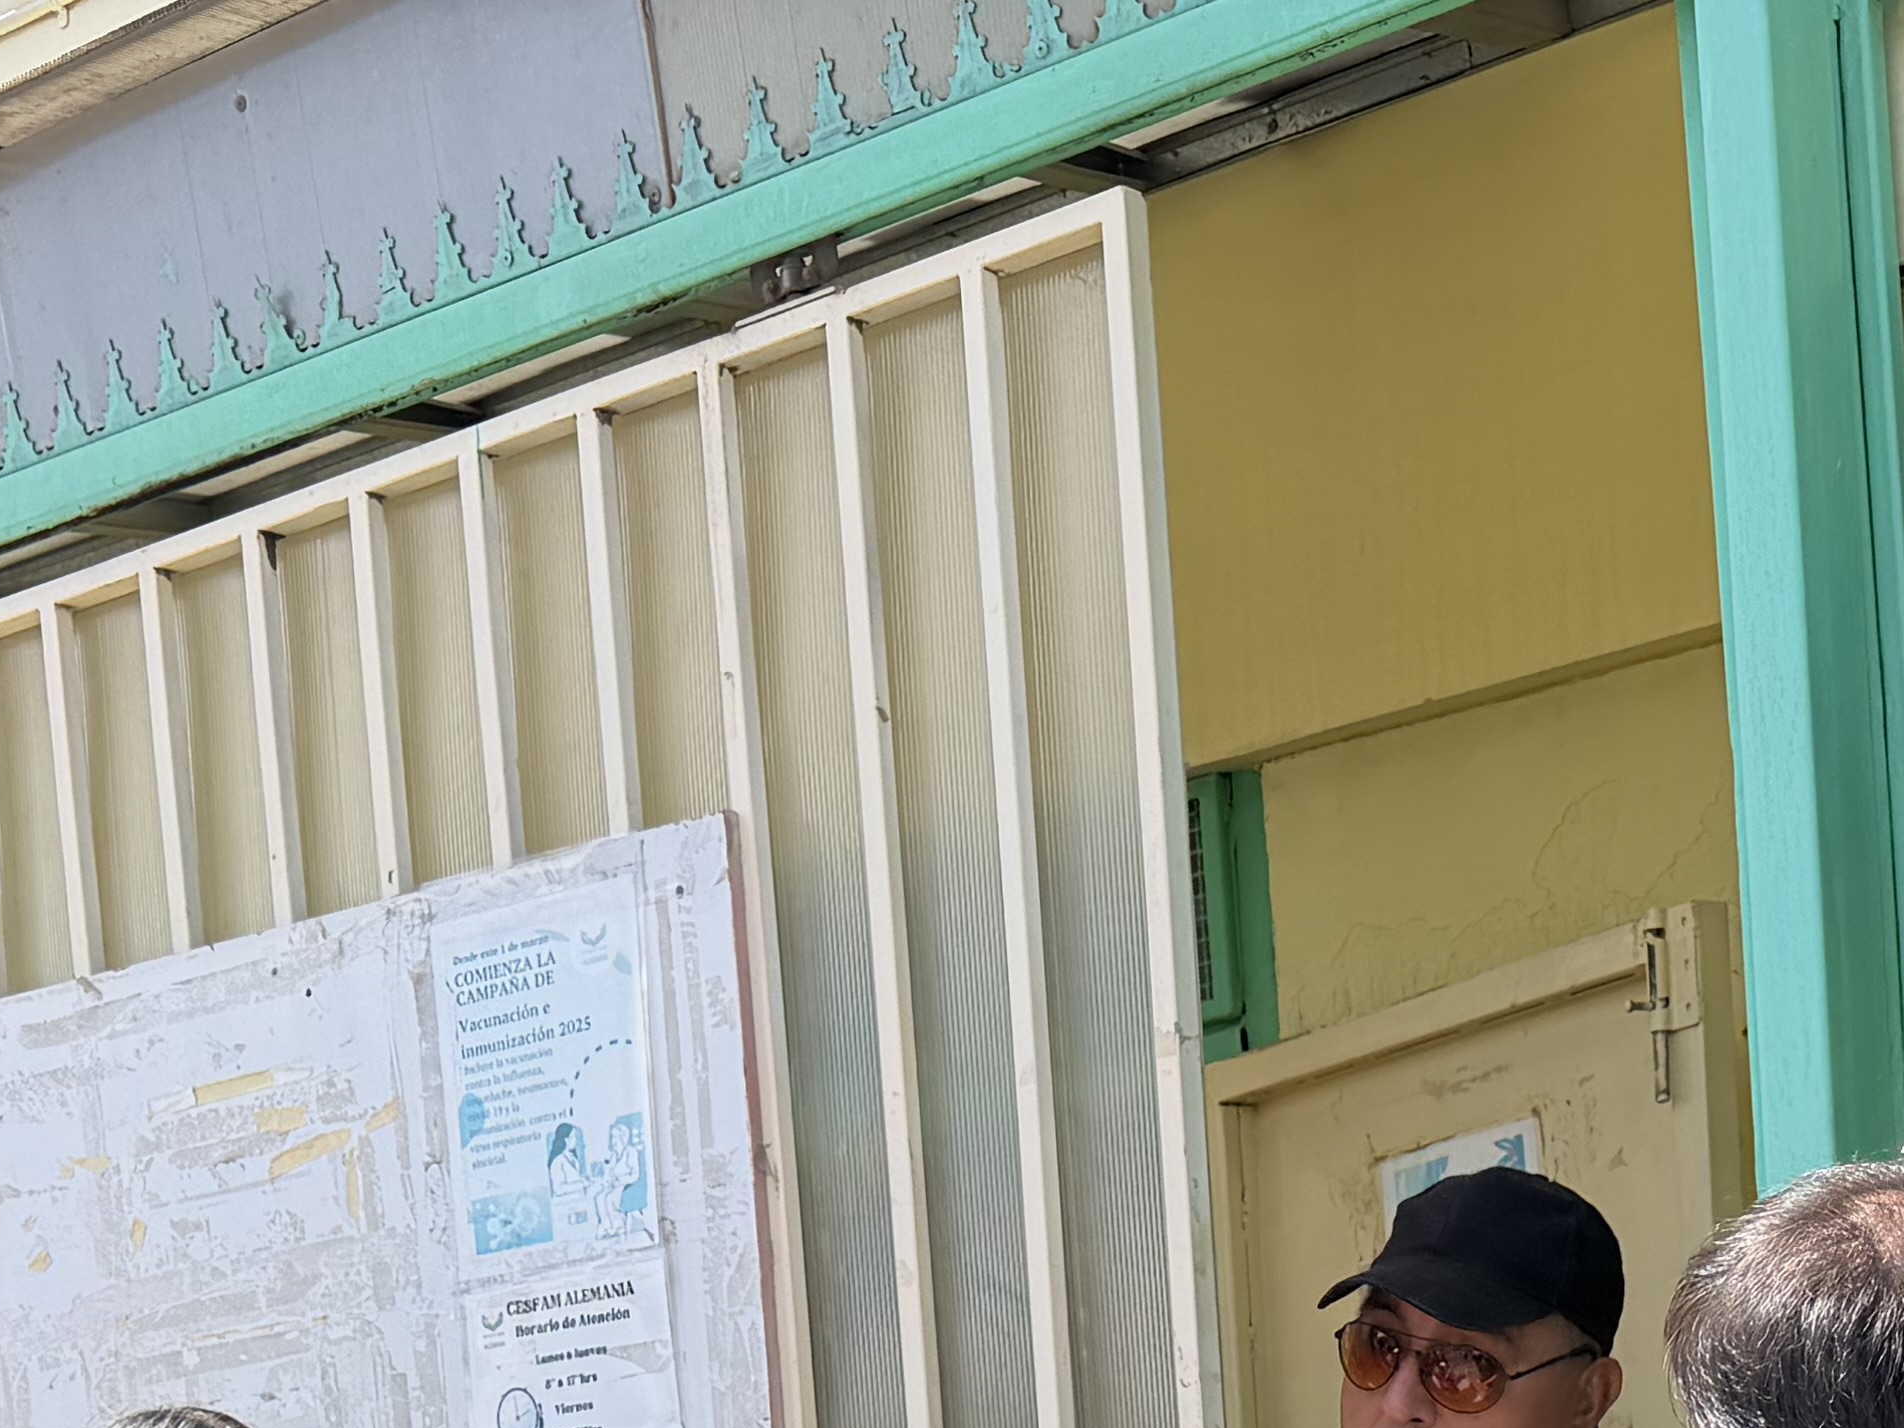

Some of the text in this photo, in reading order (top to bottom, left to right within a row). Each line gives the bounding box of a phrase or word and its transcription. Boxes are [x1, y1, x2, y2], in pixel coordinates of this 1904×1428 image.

[508, 941, 519, 952] de
[454, 957, 533, 988] COMIENZA
[537, 951, 556, 968] LA
[456, 970, 555, 1007] CAMPAÑA DE
[459, 1001, 551, 1034] Vacunación e
[461, 1015, 592, 1060] inmunización 2025
[506, 1280, 635, 1317] CESFAM ALEMANIA
[515, 1307, 631, 1338] Horario de Atención
[555, 1401, 594, 1416] Viernes
